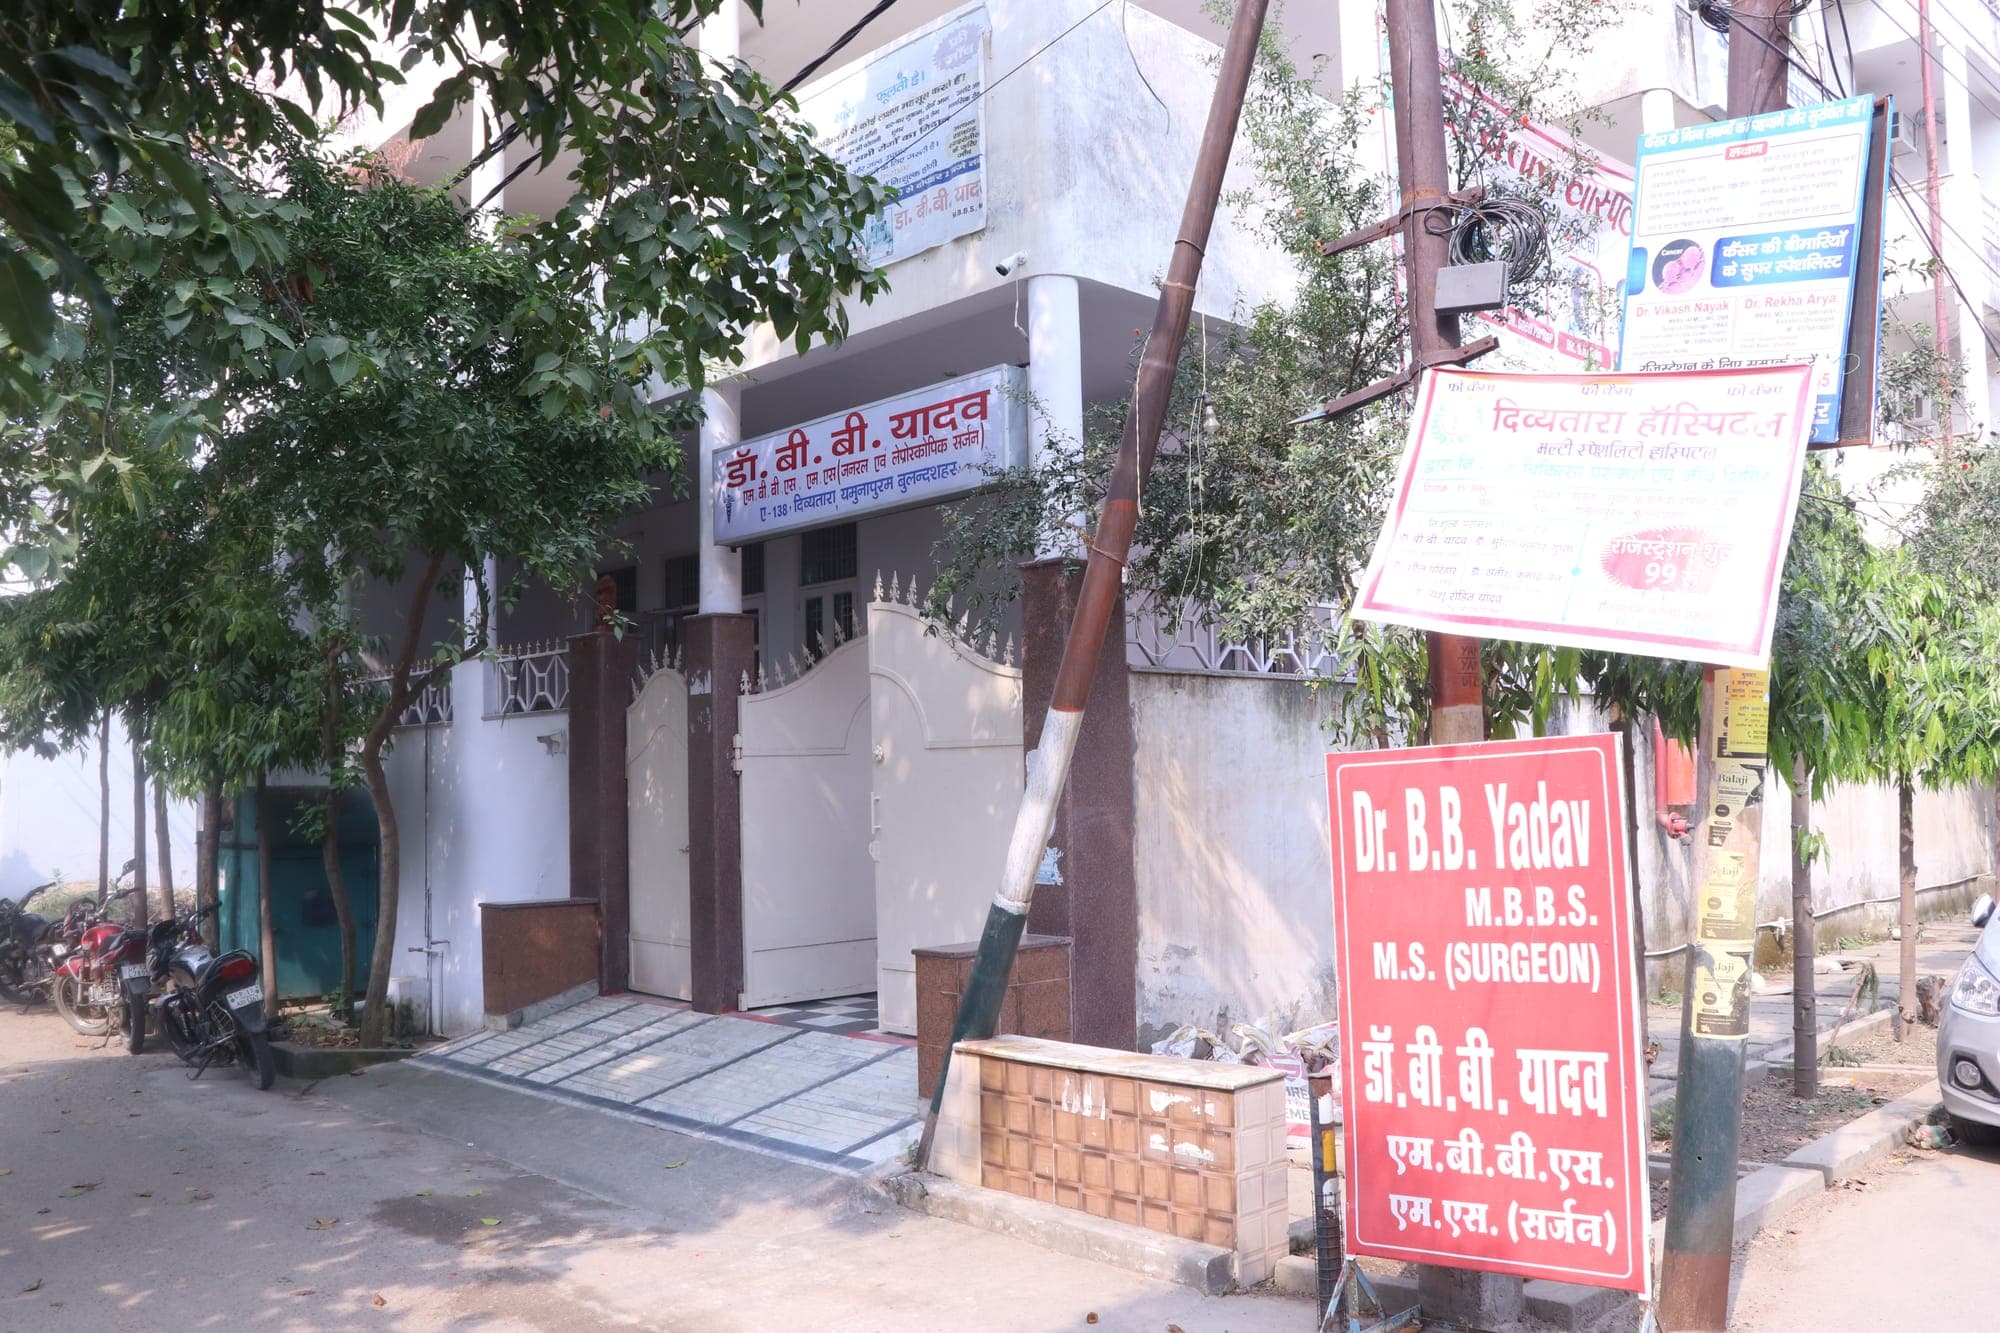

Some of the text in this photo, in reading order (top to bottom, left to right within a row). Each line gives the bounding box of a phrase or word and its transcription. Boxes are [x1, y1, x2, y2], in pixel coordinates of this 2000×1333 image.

[1660, 247, 1684, 257] Cancer
[1761, 237, 1782, 256] की
[1721, 261, 1738, 278] के
[1654, 302, 1691, 316] Vikash
[1694, 299, 1730, 314] Nayak
[1764, 295, 1804, 309] Rekha
[1806, 292, 1838, 307] Arya
[726, 448, 769, 489] डॉ.
[889, 388, 992, 440] यादव
[1491, 397, 1628, 435] दिव्यतारा
[1636, 401, 1788, 439] हॉस्पिटल
[1536, 438, 1573, 458] मल्टी
[840, 475, 894, 505] यमुनापुरम
[897, 460, 959, 494] बुलन्दशहर
[1352, 780, 1591, 873] Dr. B.B. Yadav
[1465, 886, 1599, 928] M.B.B.S.
[1372, 941, 1601, 993] M.S. (SURGEON)
[1516, 1047, 1609, 1119] यादव
[1386, 1127, 1616, 1190] एम.बी.बी.एस.
[1388, 1192, 1618, 1256] एम.एस. (सर्जन)
